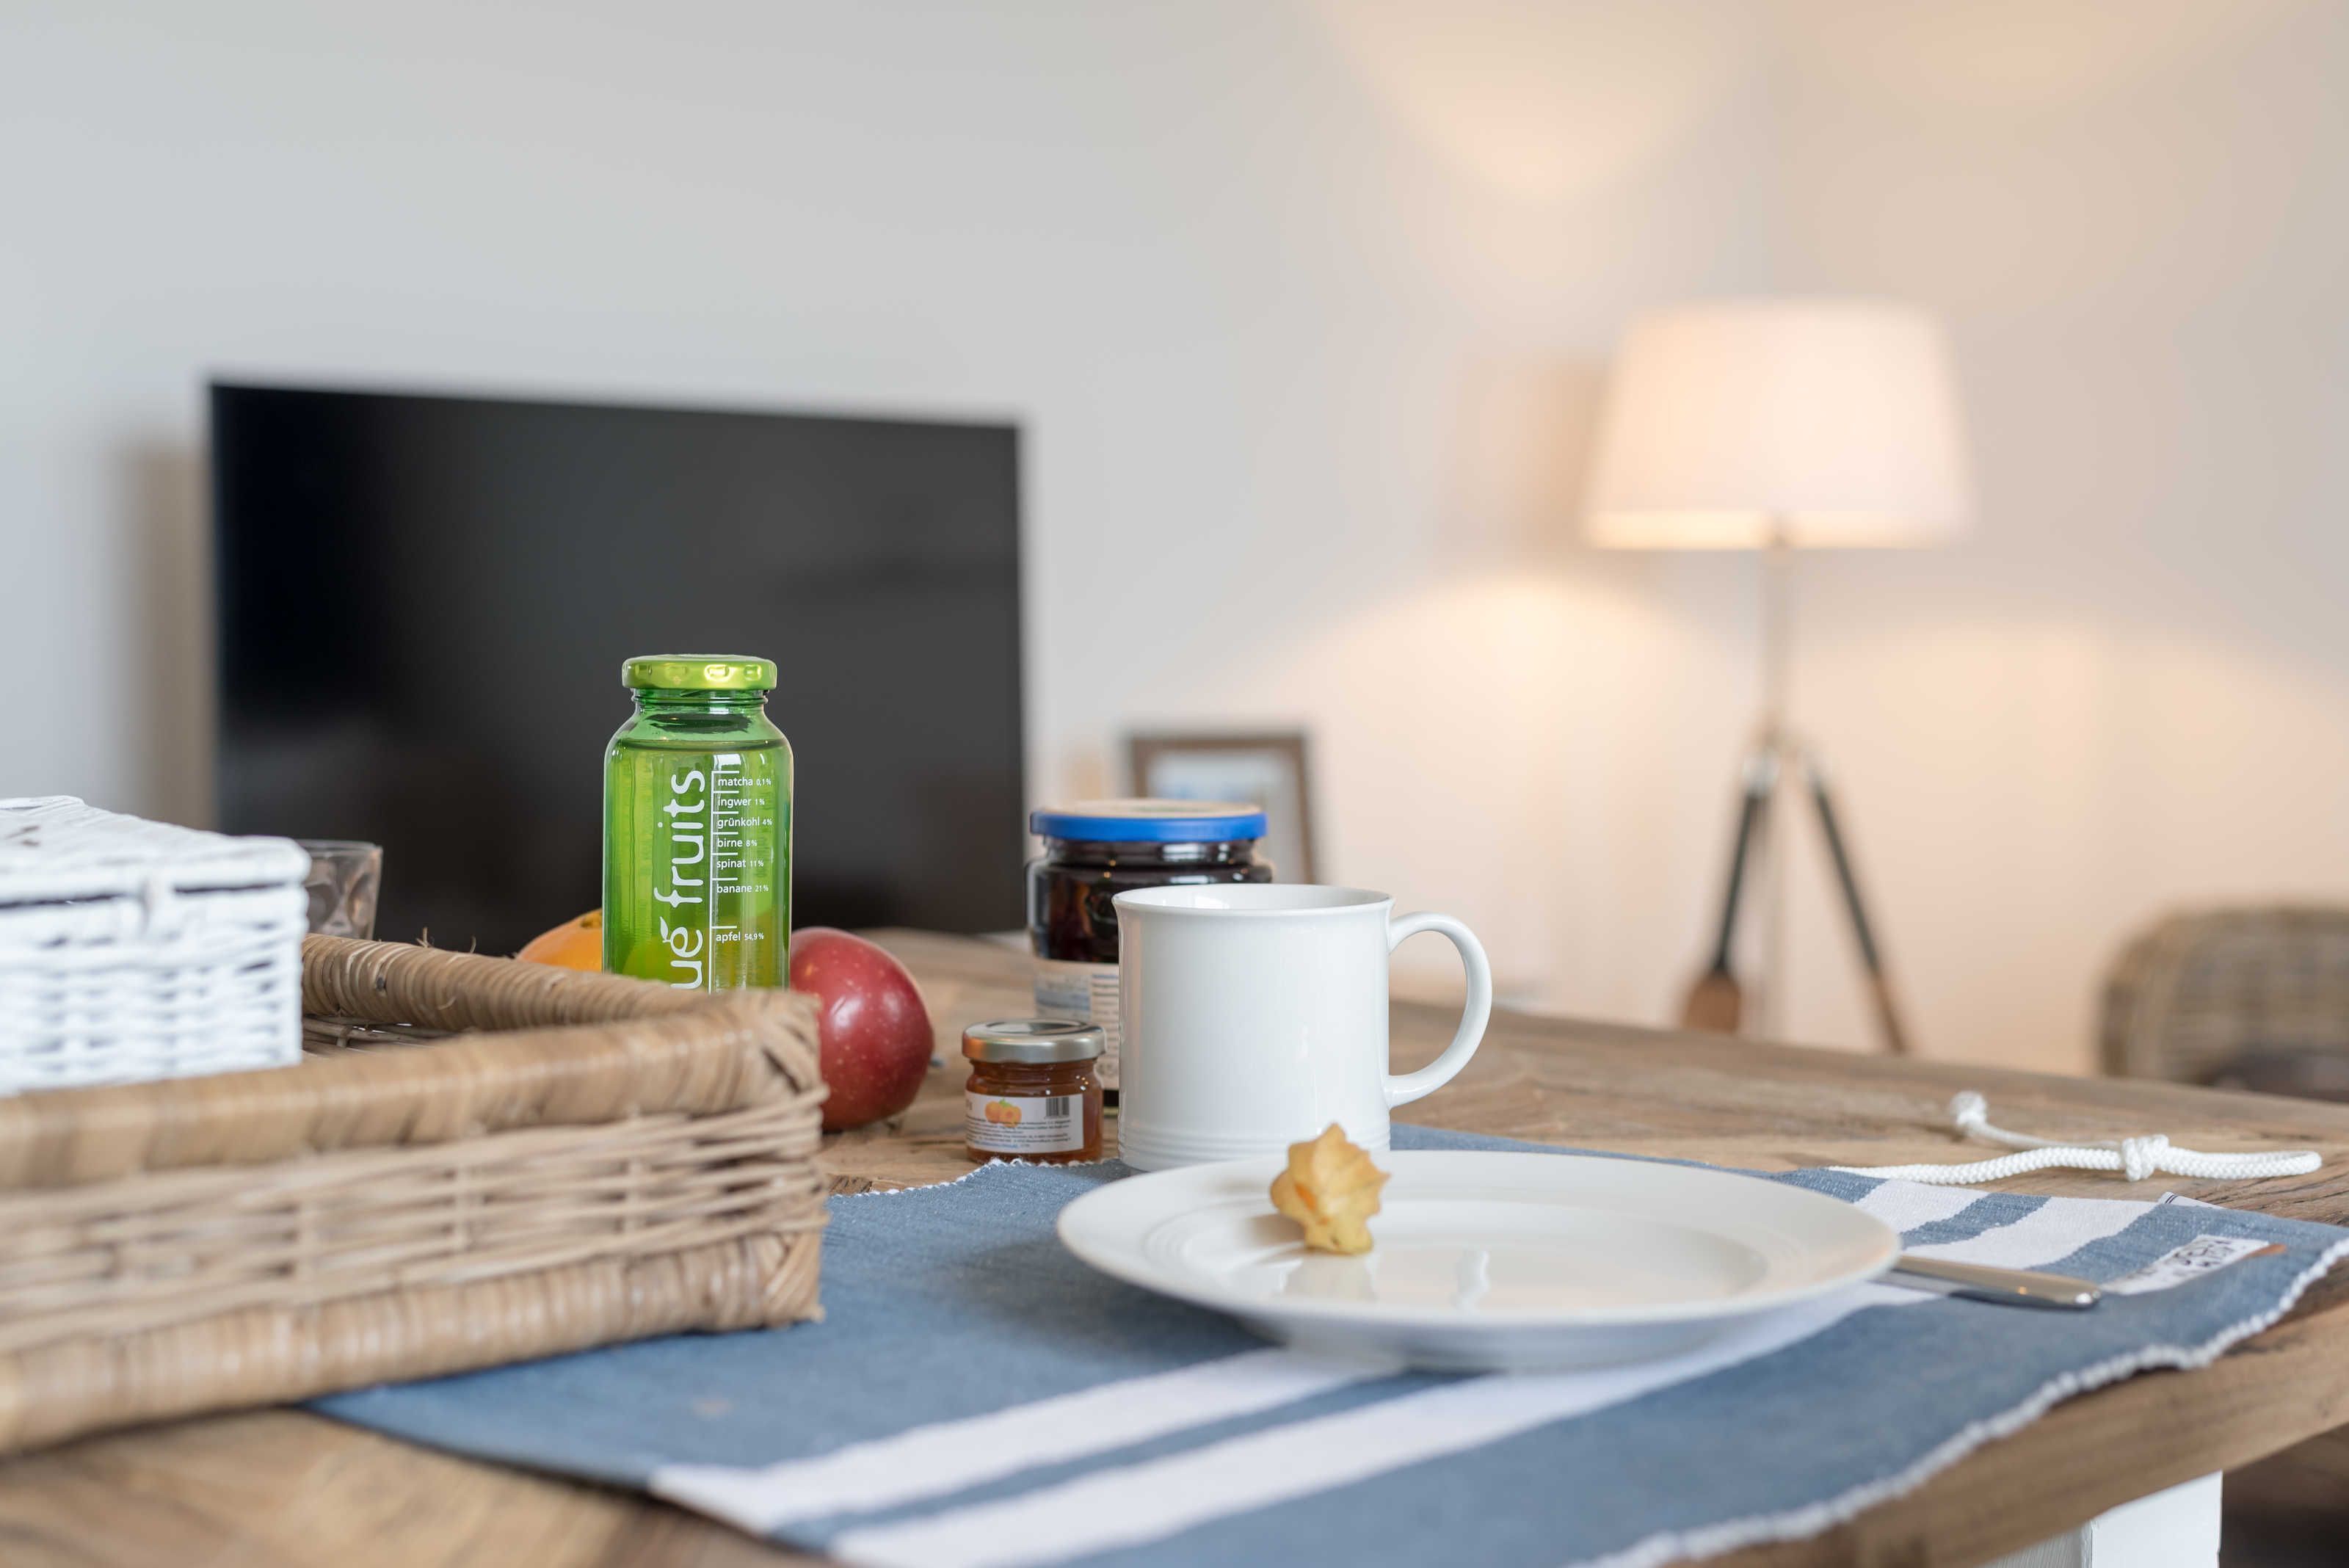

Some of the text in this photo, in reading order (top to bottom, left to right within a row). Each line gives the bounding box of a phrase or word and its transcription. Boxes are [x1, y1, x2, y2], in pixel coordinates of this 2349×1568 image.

[718, 777, 753, 787] matcha
[718, 796, 752, 808] ingwer
[717, 816, 760, 829] grünkohl
[653, 770, 705, 908] fruits
[717, 838, 743, 847] birne
[716, 859, 747, 870] spinat
[716, 884, 752, 893] banane
[716, 932, 741, 944] apfel
